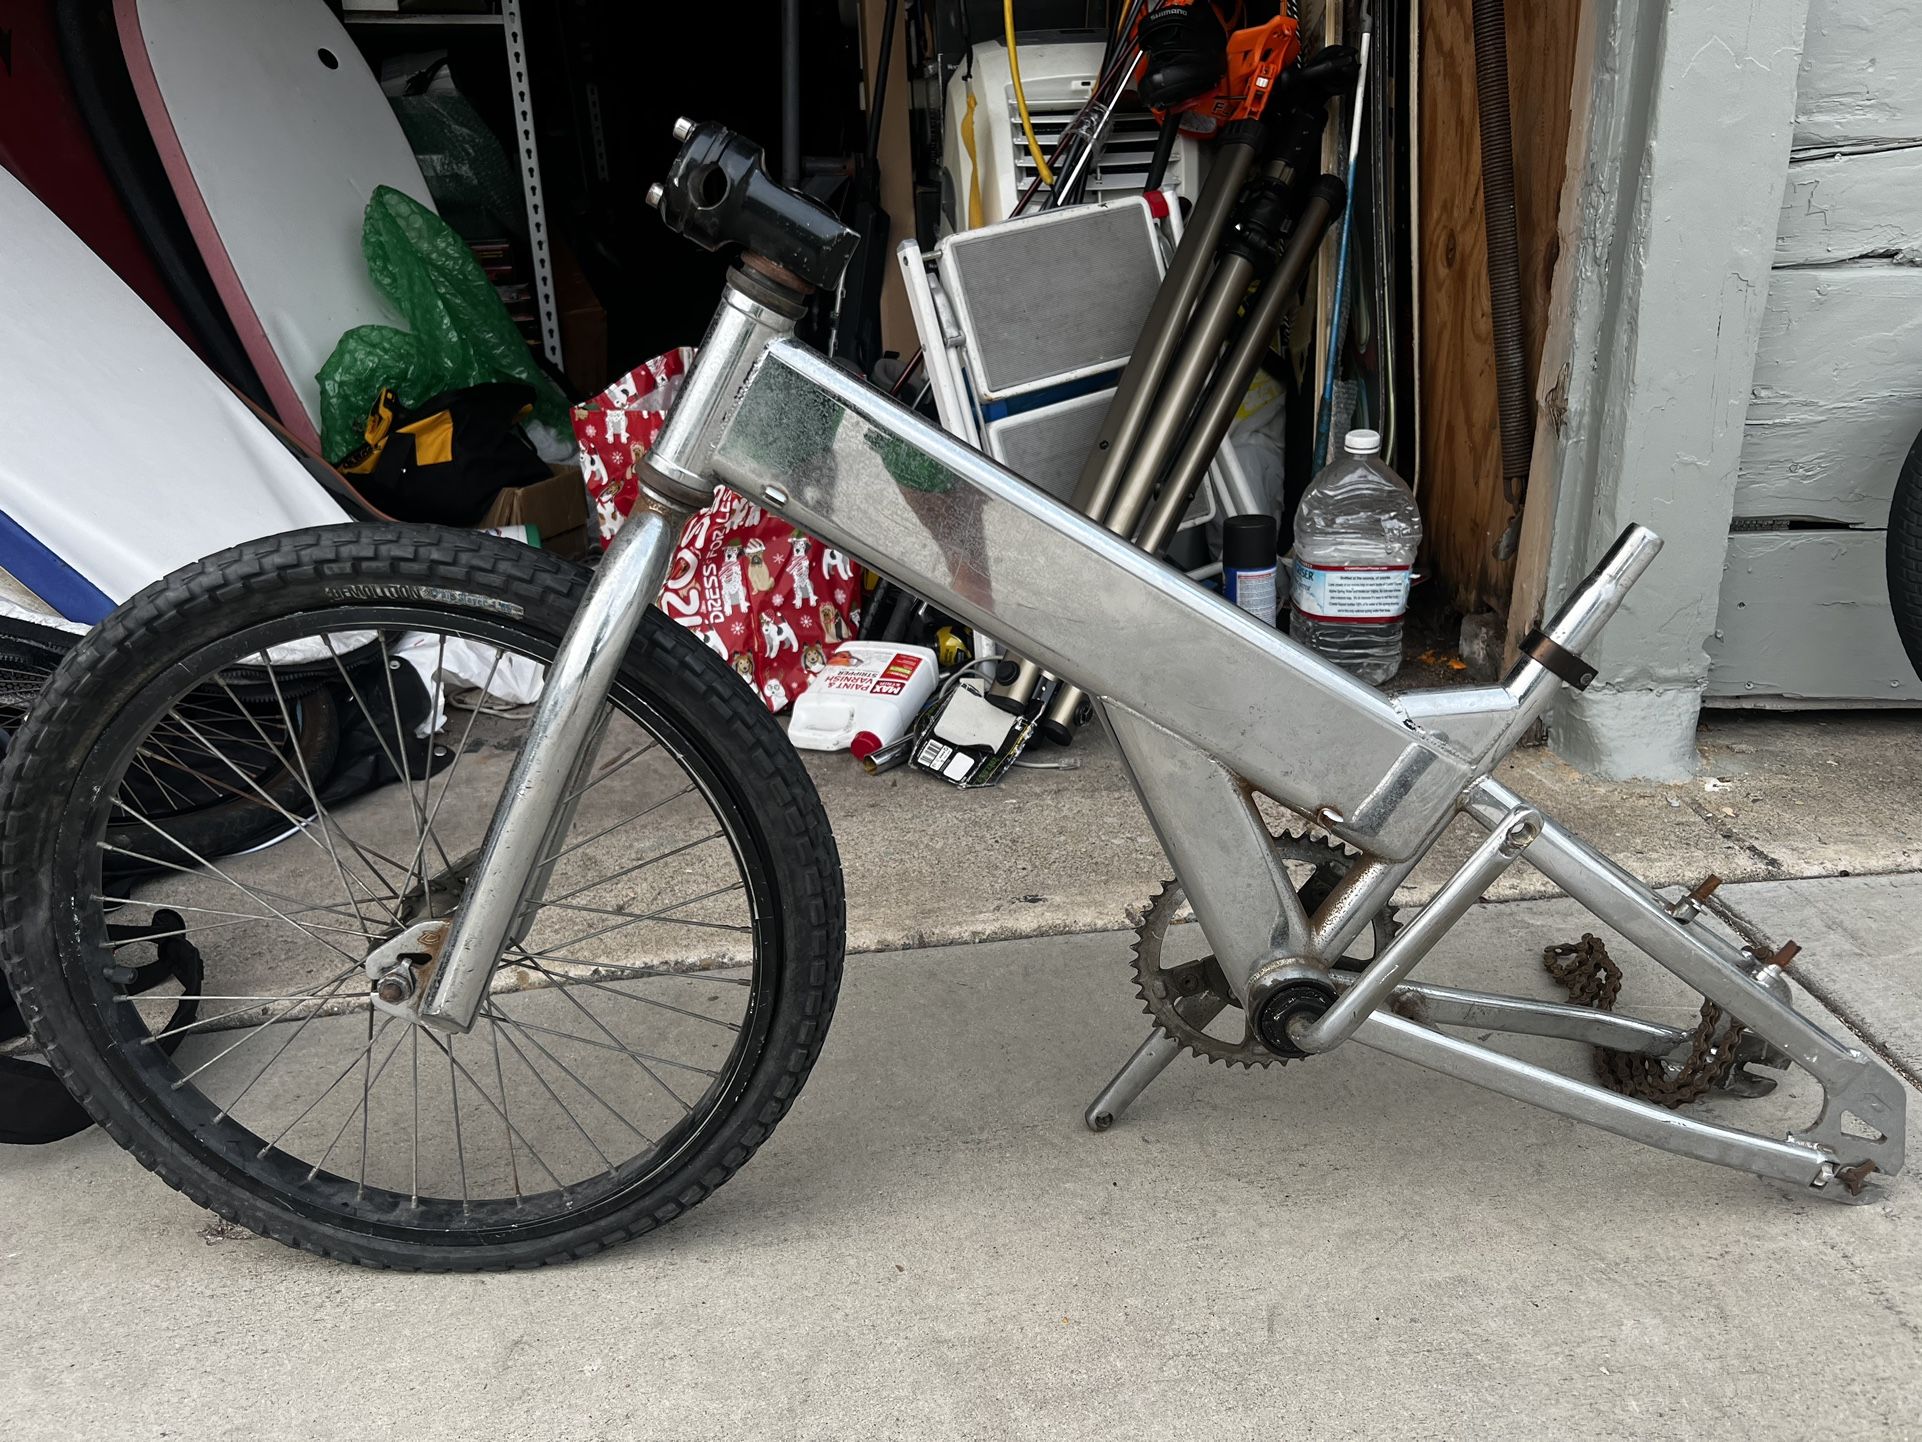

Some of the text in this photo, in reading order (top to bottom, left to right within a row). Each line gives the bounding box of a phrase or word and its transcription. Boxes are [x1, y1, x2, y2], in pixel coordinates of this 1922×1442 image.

[703, 489, 732, 624] DRESS FOR LES
[824, 676, 873, 684] VARNISH
[837, 683, 870, 691] PAINT
[871, 685, 901, 694] MAX
